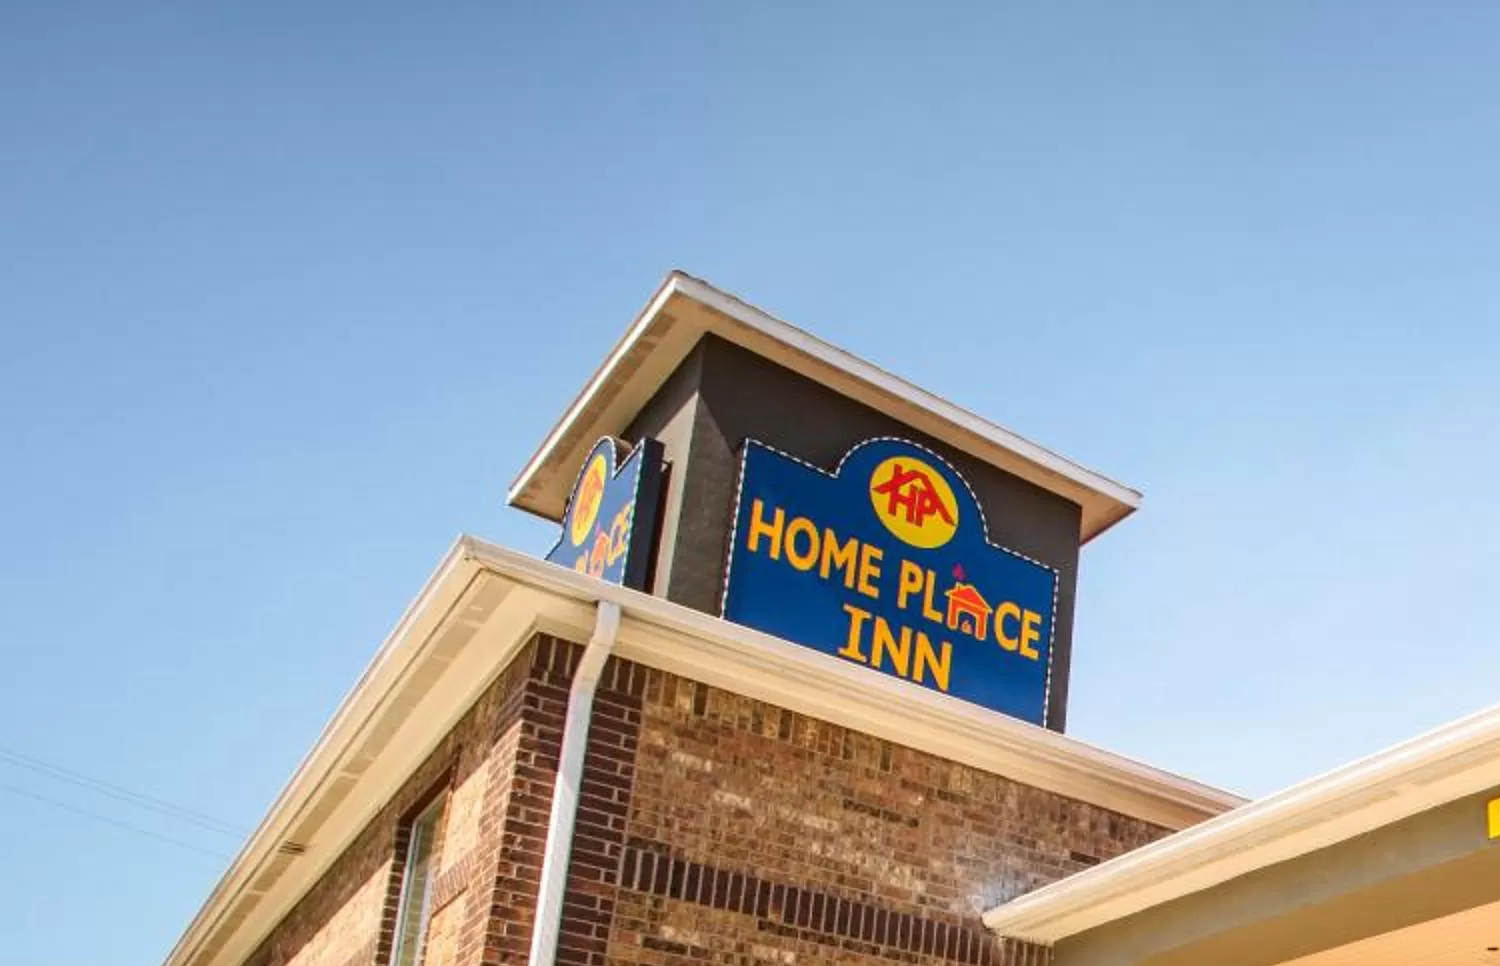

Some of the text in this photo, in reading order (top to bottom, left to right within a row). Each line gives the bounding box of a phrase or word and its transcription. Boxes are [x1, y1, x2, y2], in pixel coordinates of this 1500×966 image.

[747, 498, 1042, 661] HOME PLACE
[837, 603, 952, 691] INN
